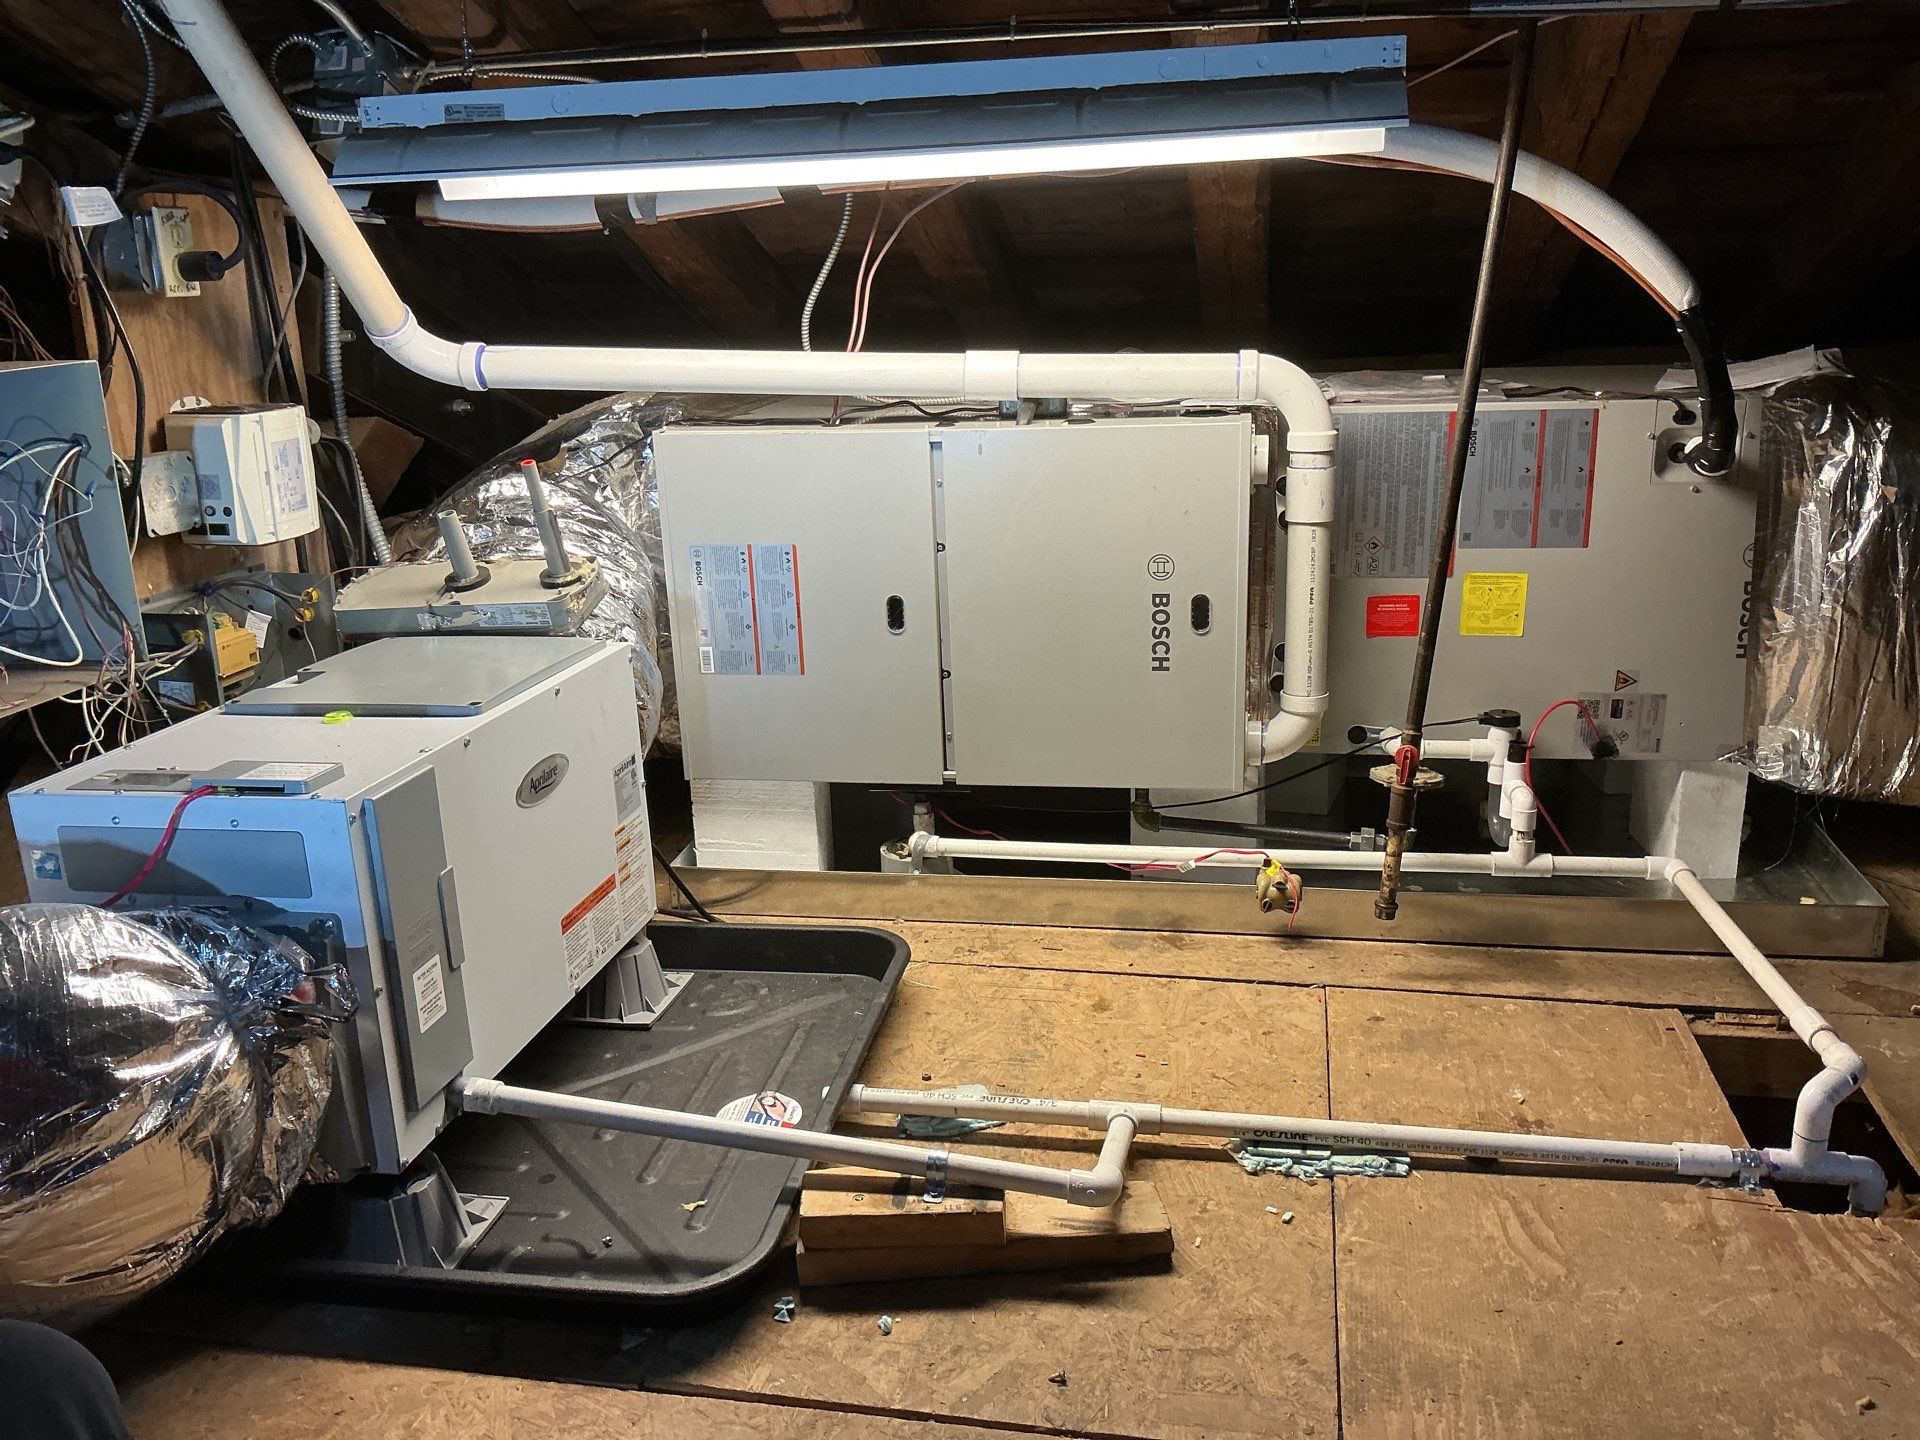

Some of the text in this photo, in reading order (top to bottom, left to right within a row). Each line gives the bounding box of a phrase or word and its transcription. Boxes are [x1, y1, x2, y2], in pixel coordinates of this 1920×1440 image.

[1468, 430, 1478, 457] BOSCH
[694, 561, 704, 586] BOSCH
[1151, 593, 1171, 672] BOSCH
[530, 765, 558, 794] Aprilaire
[922, 1091, 936, 1099] 40
[937, 1092, 957, 1101] SCH
[1333, 1135, 1355, 1145] SCH
[1357, 1137, 1372, 1146] 40
[1540, 1152, 1560, 1160] ASTM
